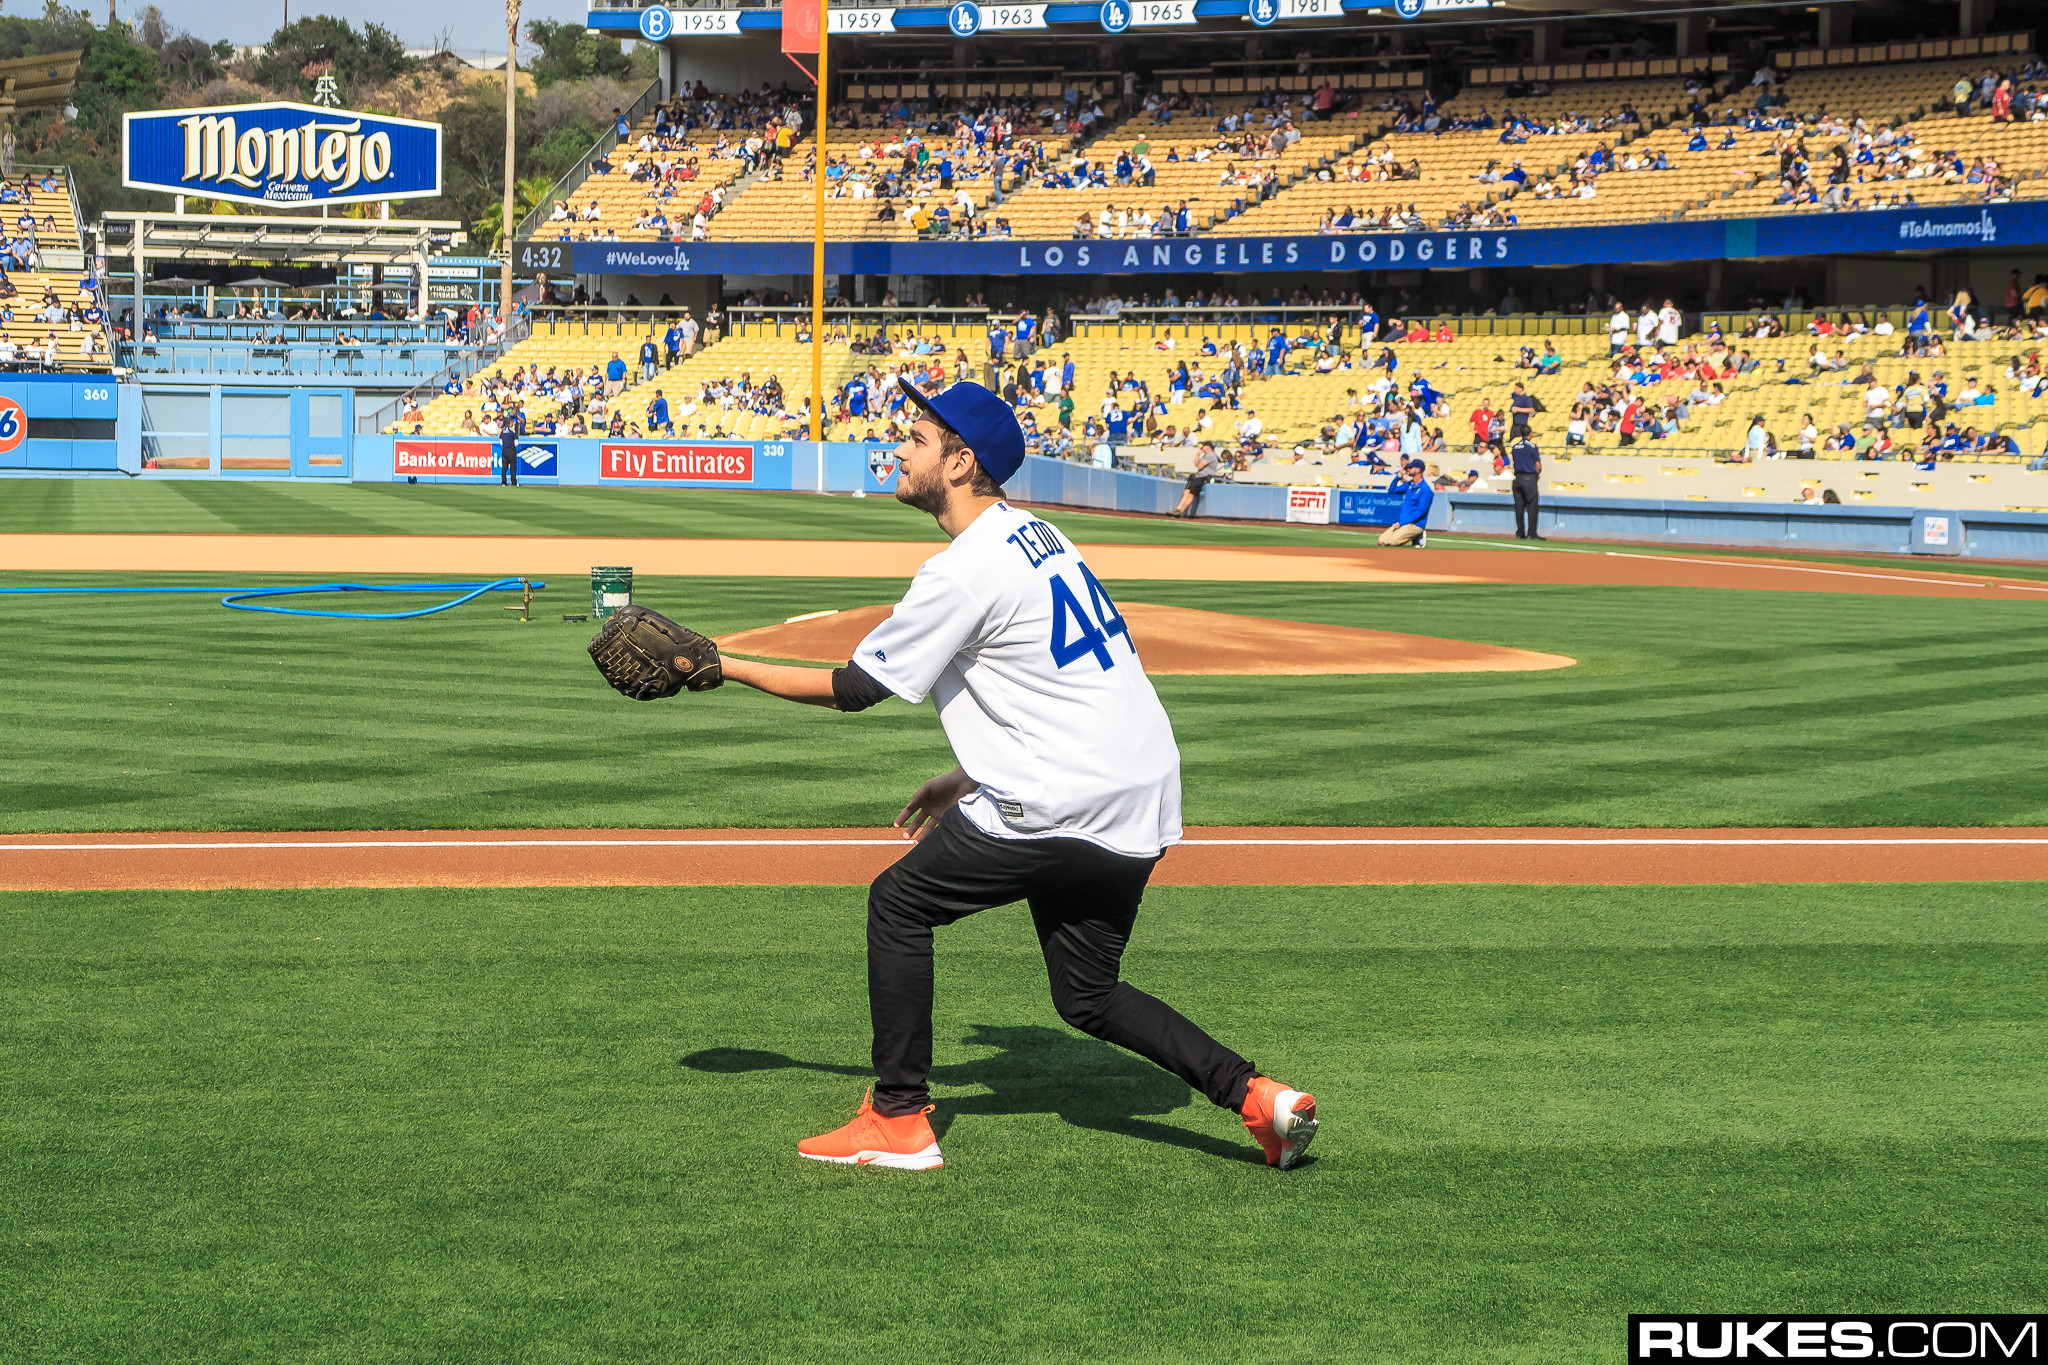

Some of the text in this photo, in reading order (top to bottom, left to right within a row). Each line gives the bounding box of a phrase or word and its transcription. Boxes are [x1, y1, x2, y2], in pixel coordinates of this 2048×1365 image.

[1143, 4, 1182, 20] 1965
[1291, 0, 1327, 13] 1981
[684, 15, 726, 30] 1955
[839, 12, 881, 28] 1959
[992, 8, 1032, 25] 1963
[177, 115, 392, 193] Montejo
[268, 181, 309, 192] Cerveza
[263, 190, 313, 201] Mexicana
[521, 246, 562, 268] 4:32
[1020, 236, 1508, 267] LOS ANGELES DODGERS
[83, 388, 109, 401] 360
[0, 408, 19, 440] 6
[763, 444, 785, 457] 330
[398, 451, 508, 469] Bank of Ameri
[610, 449, 746, 477] Fly Emirates
[1290, 490, 1327, 509] ESPN
[1006, 521, 1065, 569] ZEDD
[1049, 560, 1136, 672] 44
